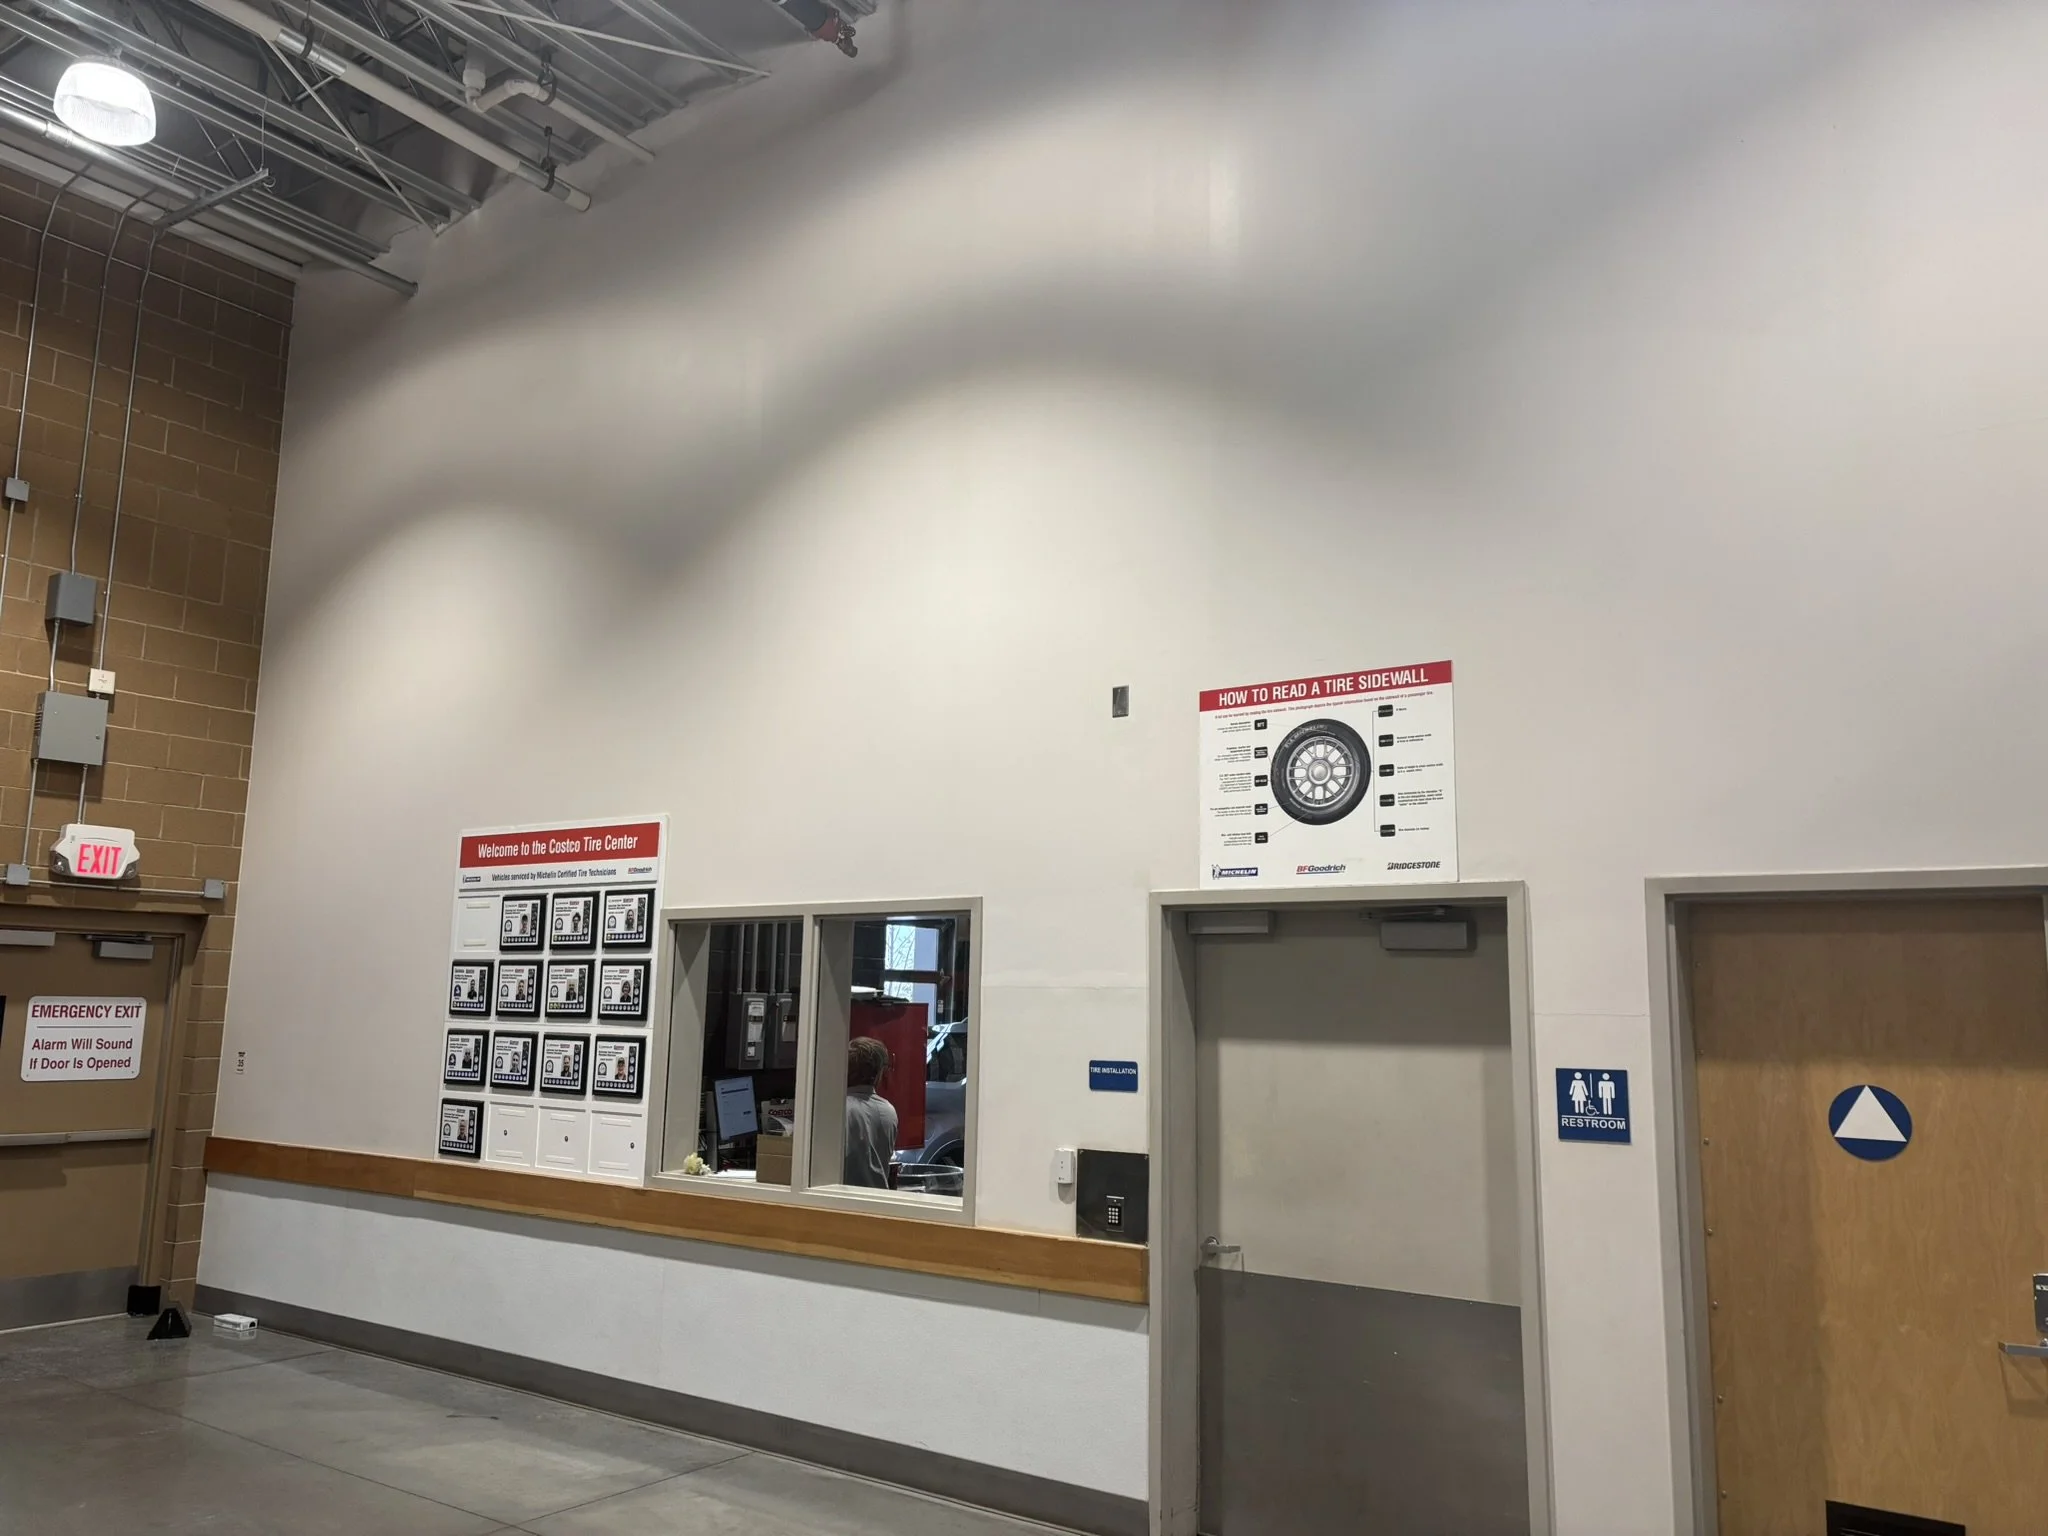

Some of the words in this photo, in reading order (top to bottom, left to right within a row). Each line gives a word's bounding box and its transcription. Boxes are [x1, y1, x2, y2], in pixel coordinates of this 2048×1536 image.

[1218, 690, 1248, 707] HOW
[1252, 687, 1269, 703] TO
[1272, 682, 1308, 700] READ
[1311, 681, 1321, 695] A
[1323, 676, 1354, 694] TIRE
[1358, 668, 1429, 690] SIDEWALL
[478, 843, 519, 859] Welcome
[520, 843, 530, 856] to
[532, 841, 547, 855] the
[549, 838, 581, 854] Costco
[583, 836, 602, 852] Tire
[604, 834, 638, 850] Center
[76, 843, 122, 876] EXIT
[1386, 860, 1441, 871] BRIDGESTONE
[491, 873, 510, 882] Vehicles
[510, 872, 530, 881] serviced
[530, 872, 537, 881] by
[536, 871, 557, 880] Michelin
[557, 869, 578, 879] Certified
[578, 868, 587, 877] Tire
[588, 867, 617, 877] Technicians
[1296, 863, 1347, 874] BFGoodrich
[31, 1004, 112, 1019] EMERGENCY
[114, 1004, 143, 1018] EXIT
[31, 1037, 67, 1051] Alarm
[71, 1037, 92, 1050] Will
[95, 1037, 133, 1050] Sound
[29, 1057, 39, 1070] If
[41, 1057, 69, 1070] Door
[72, 1057, 83, 1070] Is
[86, 1056, 132, 1072] Opened
[1090, 1066, 1101, 1074] TIRE
[1101, 1067, 1137, 1075] INSTALLATION
[1561, 1118, 1626, 1130] RESTROOM
